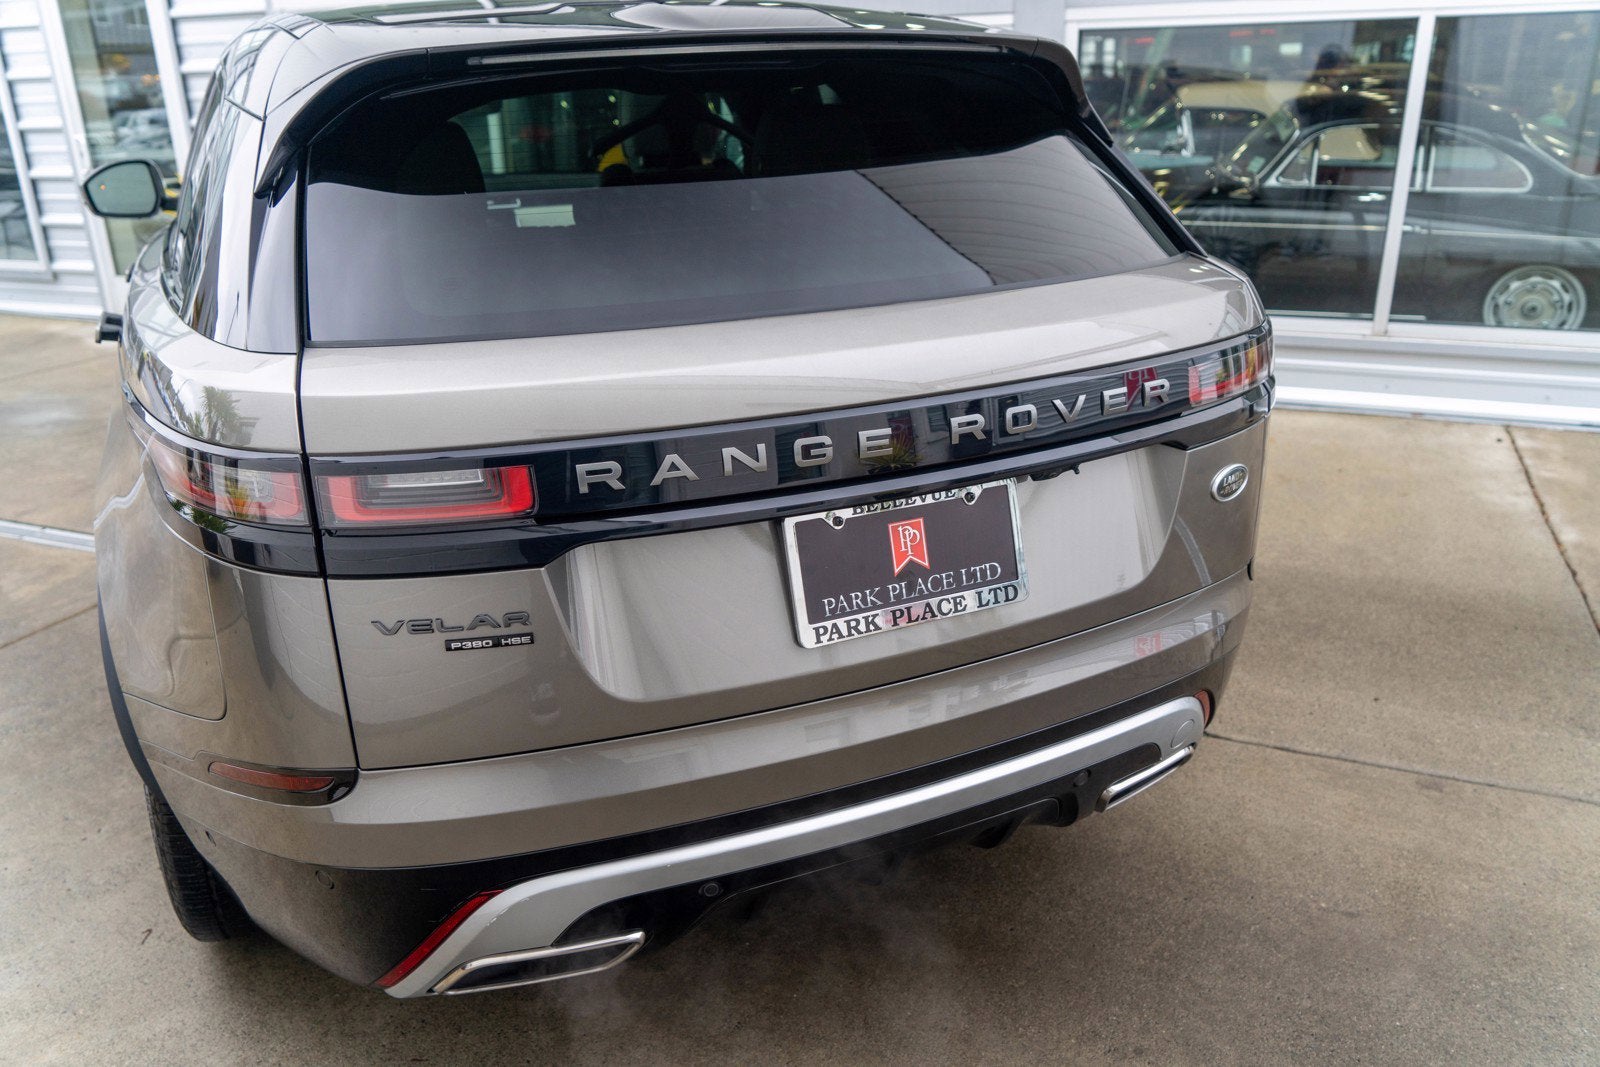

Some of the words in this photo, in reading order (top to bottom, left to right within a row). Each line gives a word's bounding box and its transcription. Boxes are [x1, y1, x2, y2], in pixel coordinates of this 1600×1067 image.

[575, 427, 894, 494] RANGE
[950, 378, 1171, 444] ROVER
[812, 616, 883, 645] PARK
[889, 594, 967, 627] PLACE
[975, 583, 1019, 609] LTD
[822, 586, 883, 617] PARK
[886, 570, 956, 604] PLACE
[961, 561, 1002, 587] LTD
[371, 611, 532, 636] VELAR
[450, 639, 493, 651] P380
[501, 635, 533, 647] HSE
